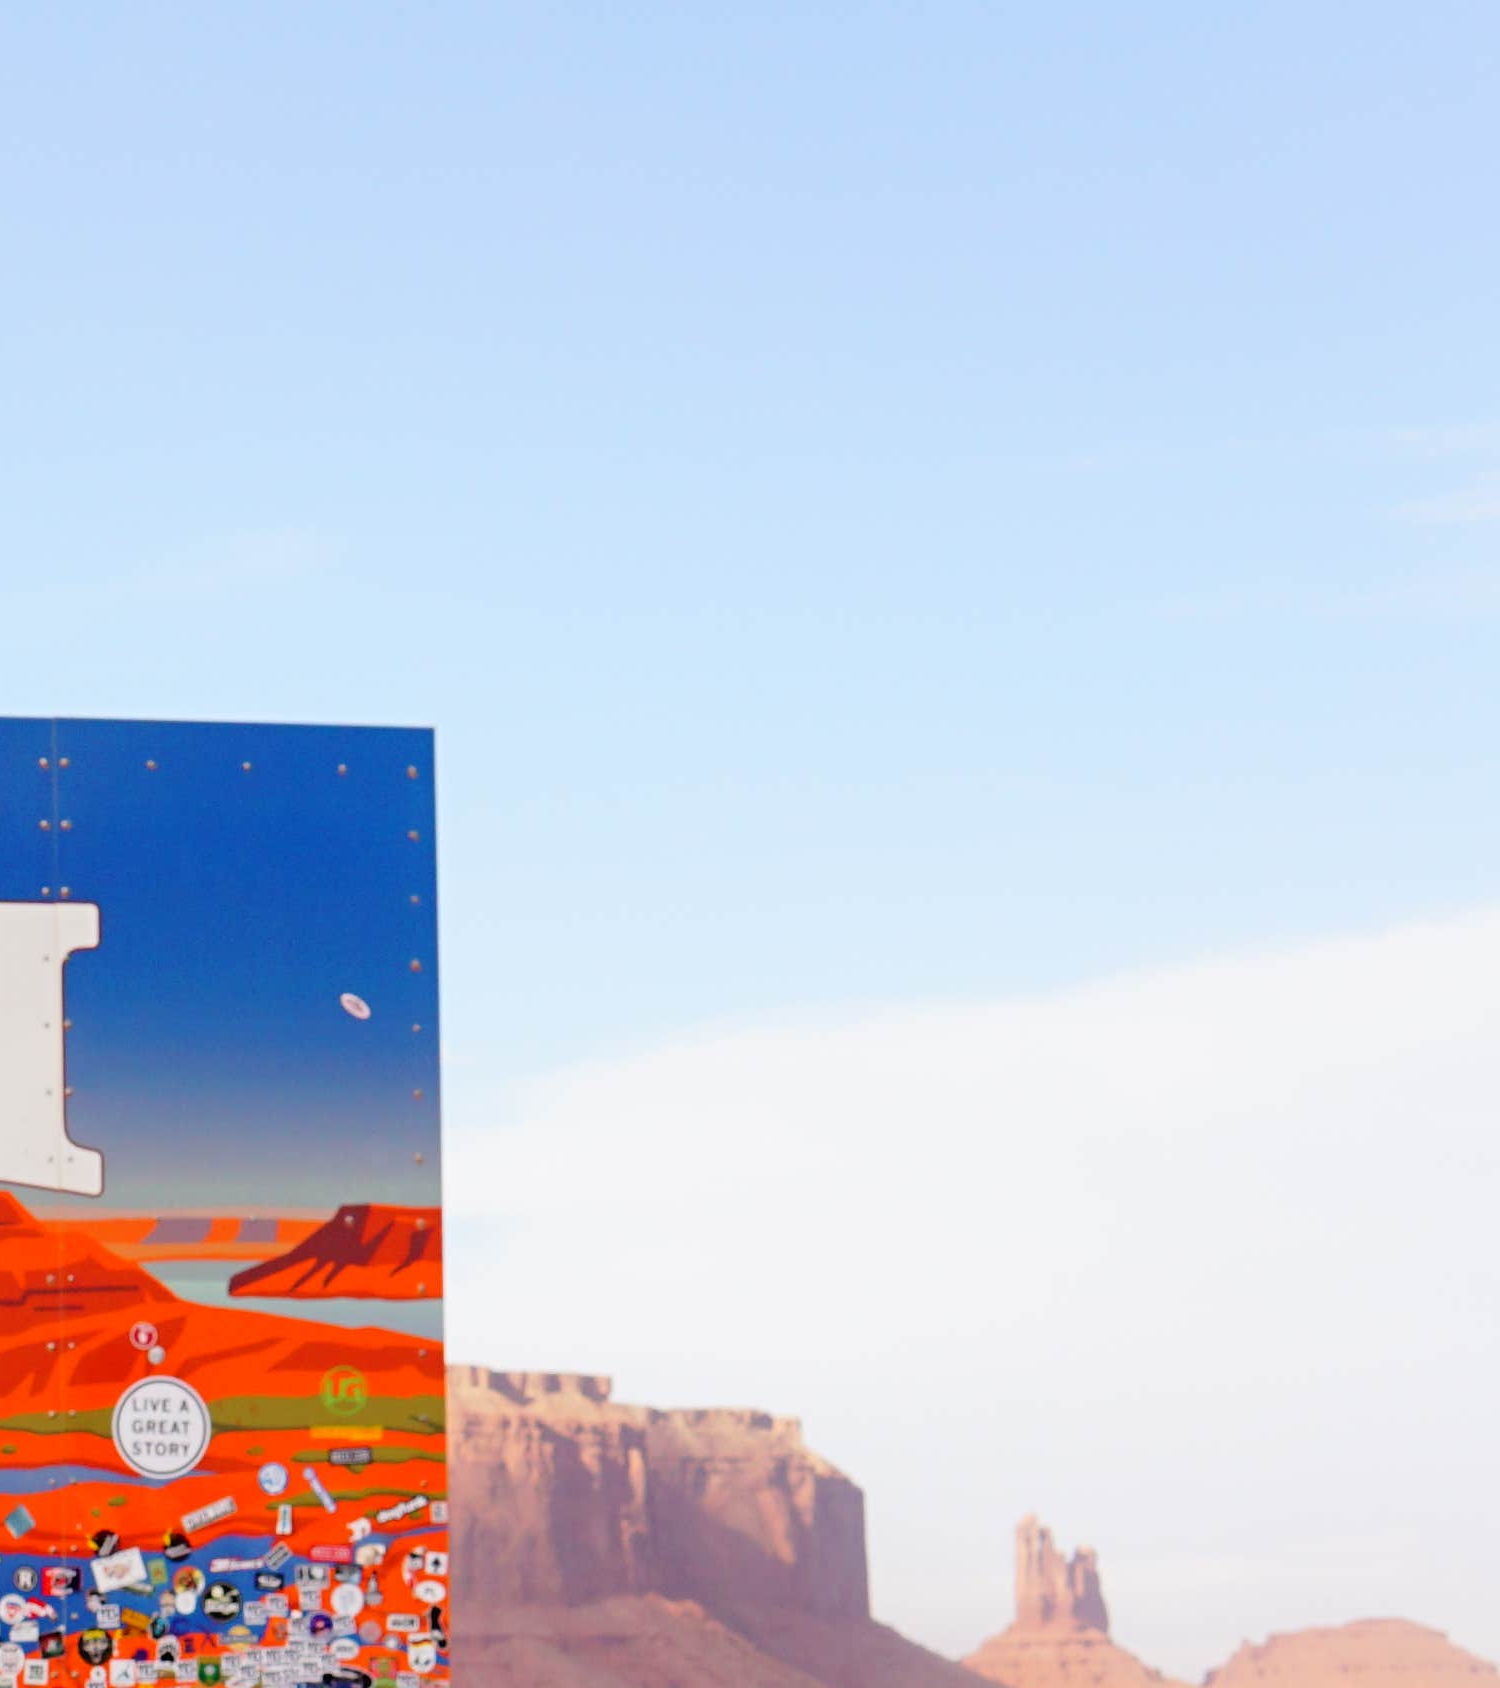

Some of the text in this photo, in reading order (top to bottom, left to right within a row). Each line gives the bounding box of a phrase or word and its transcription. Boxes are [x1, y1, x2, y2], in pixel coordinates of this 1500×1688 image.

[132, 1398, 190, 1413] LIVE A
[132, 1419, 191, 1434] GREAT
[132, 1442, 190, 1456] STORY
